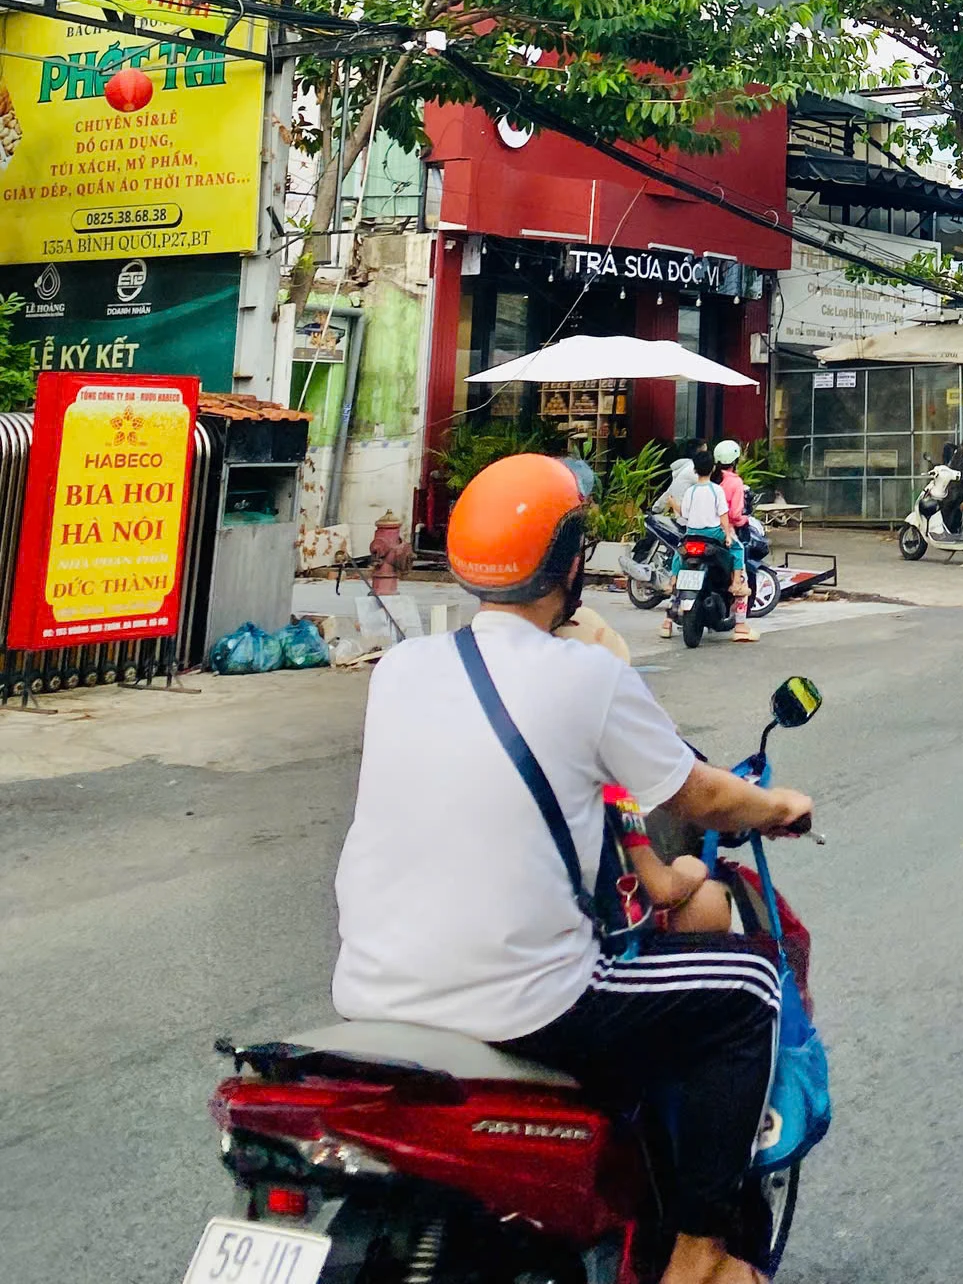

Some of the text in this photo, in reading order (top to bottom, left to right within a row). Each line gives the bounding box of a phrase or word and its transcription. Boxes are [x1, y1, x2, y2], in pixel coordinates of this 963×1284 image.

[75, 115, 131, 132] CHUYÊN
[100, 138, 124, 152] GIA
[51, 161, 74, 177] TÚI
[78, 157, 121, 174] XÁCH,
[120, 176, 139, 193] ÁO
[86, 208, 167, 226] 0825.38.68.38
[78, 234, 114, 253] BÌNH
[569, 247, 720, 292] TRÀ SỮA ĐỘC VỊ
[60, 338, 91, 369] KÝ
[96, 335, 140, 368] KẾT
[85, 453, 163, 468] HABECO
[64, 482, 175, 506] BIA HƠI
[60, 516, 165, 545] HÀ NỘI
[52, 573, 168, 598] ĐỨC THÀNH
